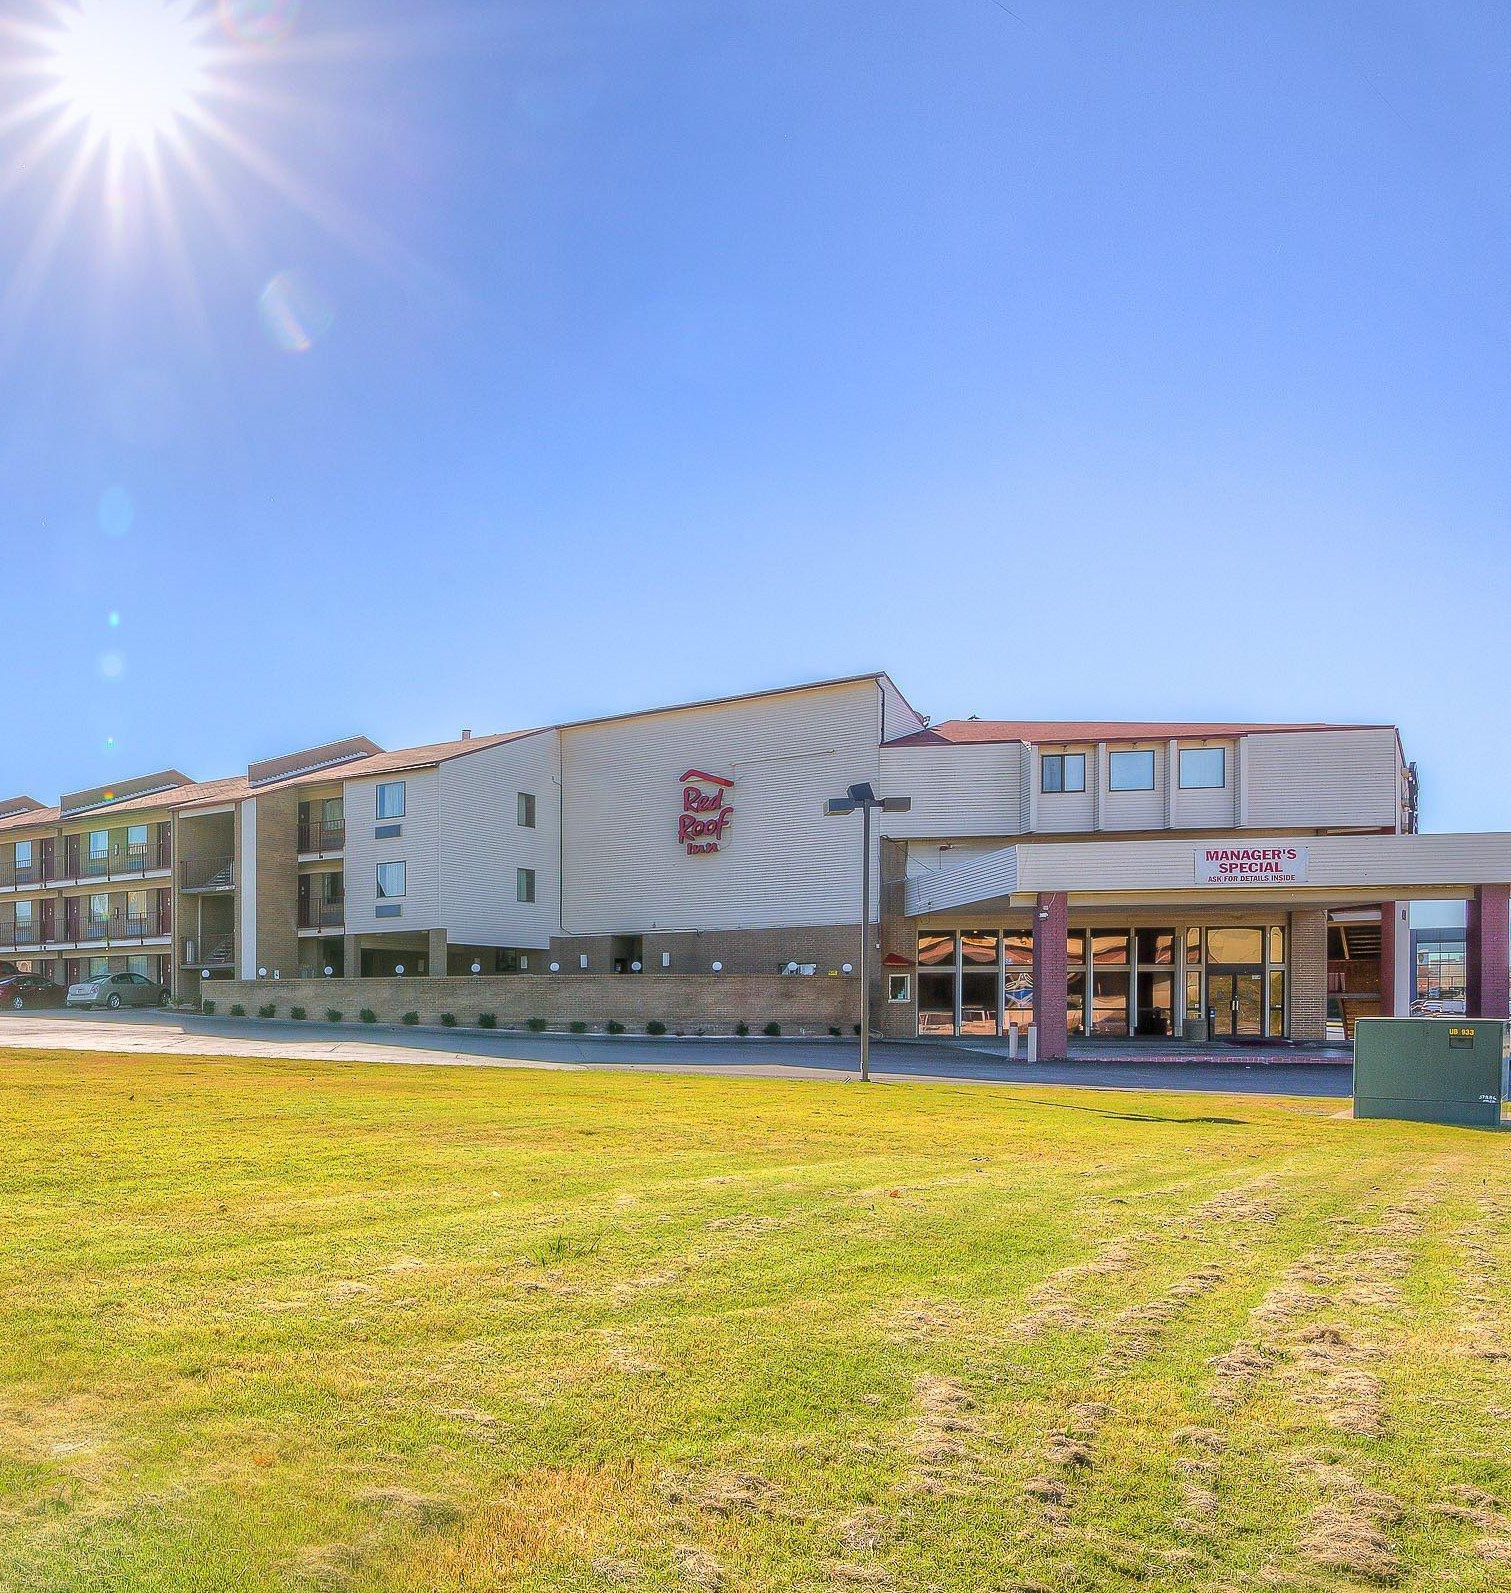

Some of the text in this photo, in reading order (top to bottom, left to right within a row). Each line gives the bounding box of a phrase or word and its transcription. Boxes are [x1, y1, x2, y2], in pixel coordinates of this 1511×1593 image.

[683, 786, 724, 813] Red
[678, 806, 734, 844] Roof
[1206, 849, 1297, 861] MANAGER'S
[1219, 862, 1284, 874] SPECIAL
